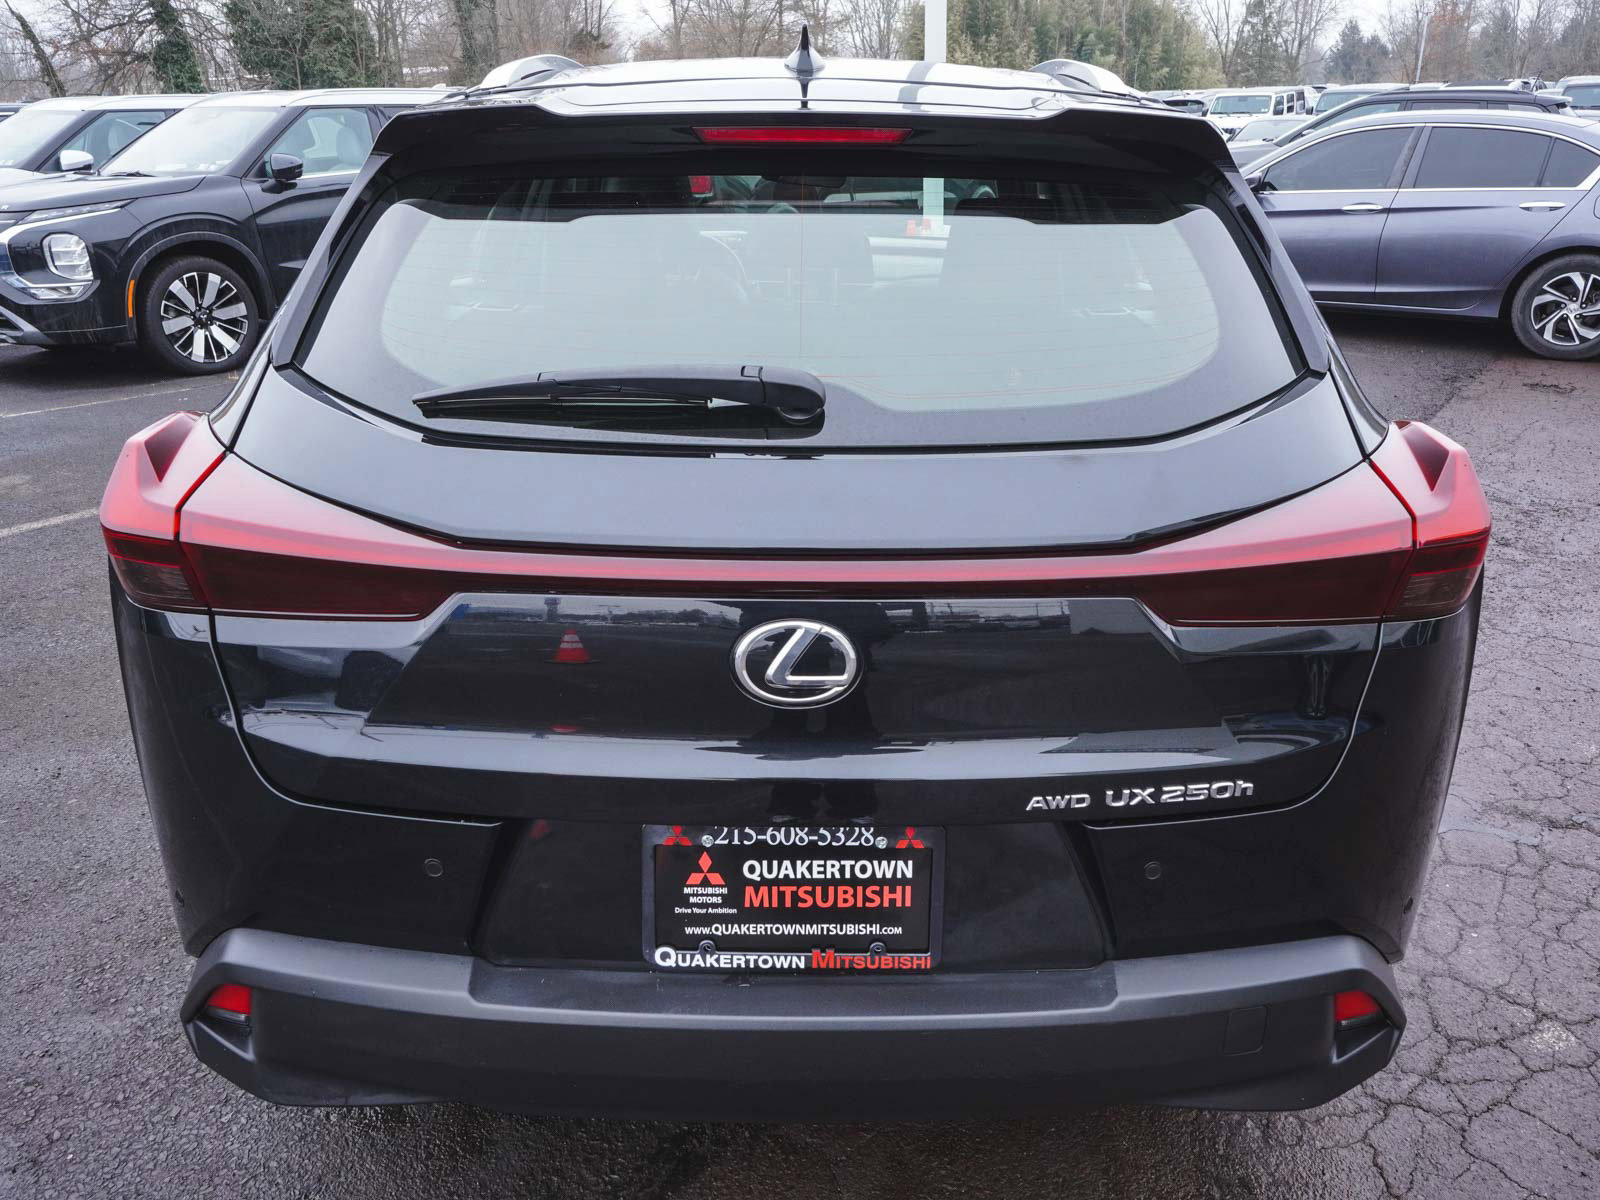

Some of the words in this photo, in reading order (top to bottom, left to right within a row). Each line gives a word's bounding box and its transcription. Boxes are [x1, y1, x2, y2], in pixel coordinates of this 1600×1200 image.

[1026, 793, 1091, 811] AWD
[714, 826, 875, 846] 215-608-5328
[742, 859, 914, 880] QUAKERTOWN
[683, 887, 728, 895] MITSUBISHI
[689, 896, 723, 904] MOTORS
[743, 885, 912, 908] MITSUBISHI
[654, 946, 806, 969] QUAKERTOWN
[811, 948, 932, 969] MITSUBISHI
